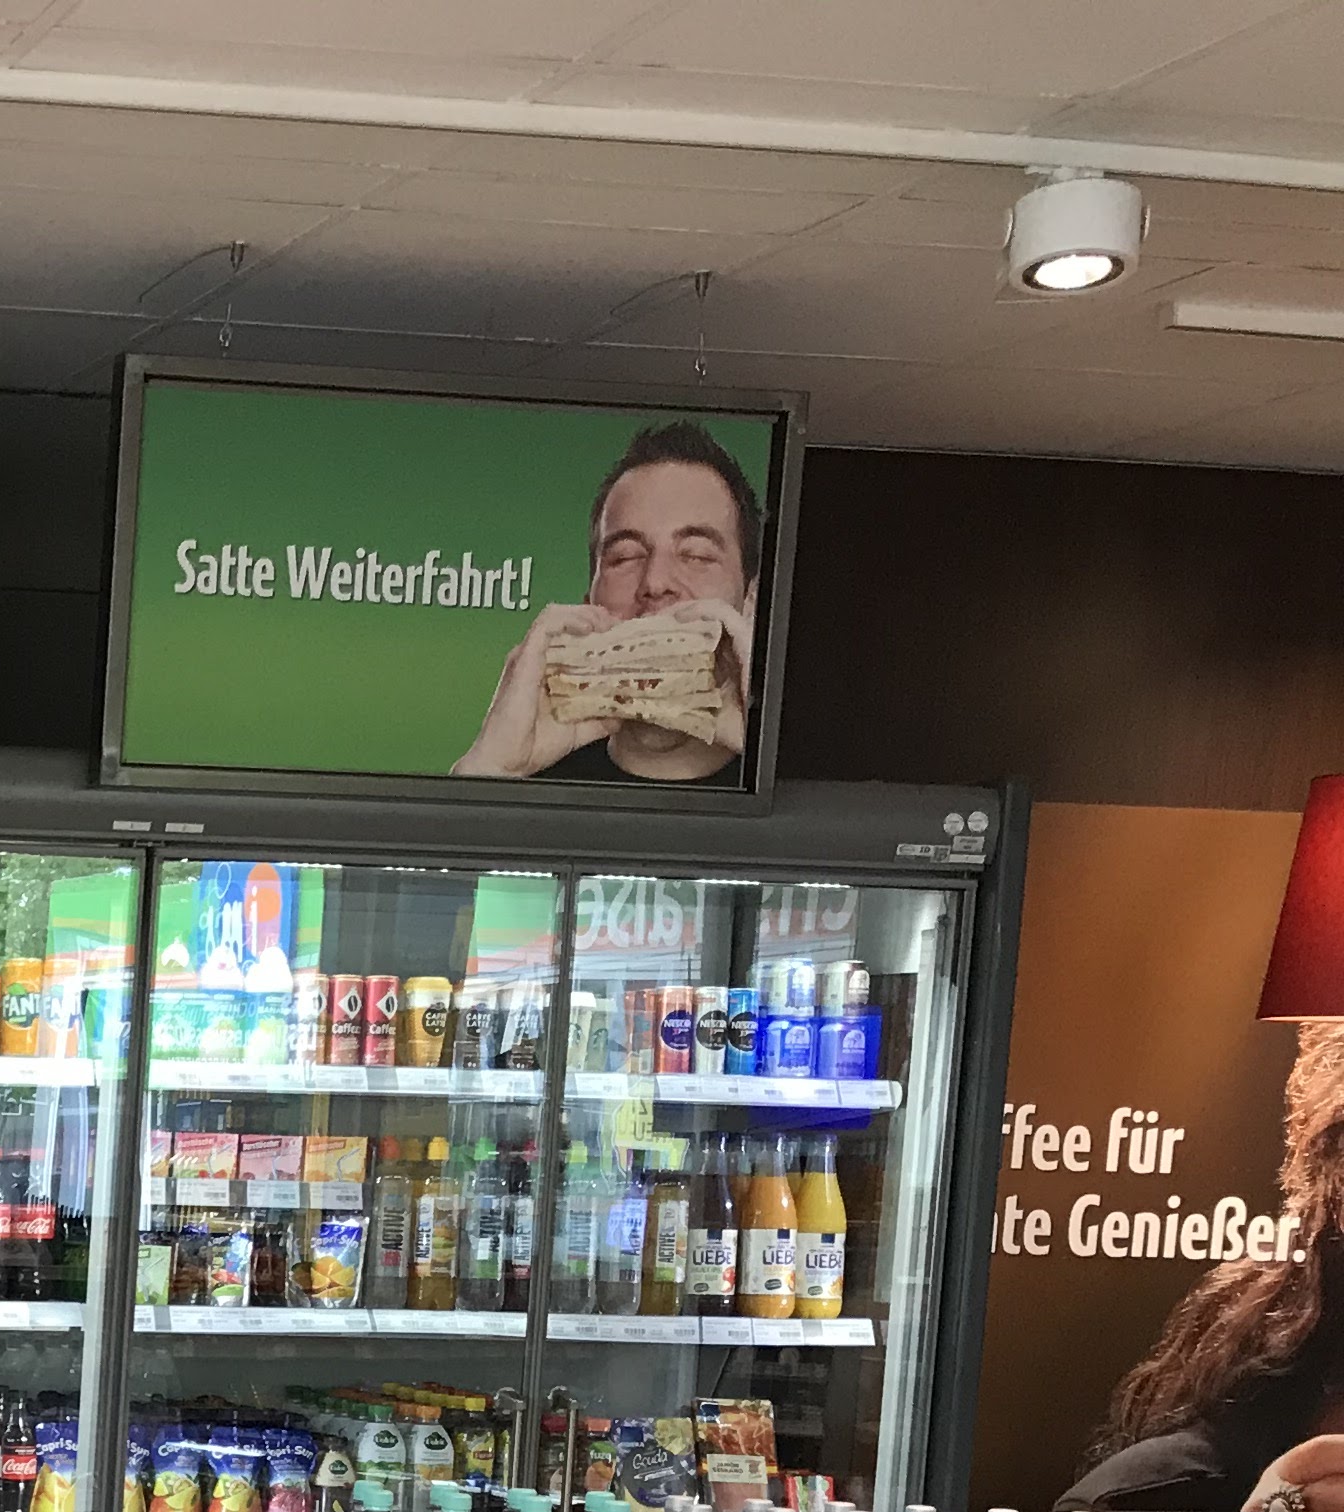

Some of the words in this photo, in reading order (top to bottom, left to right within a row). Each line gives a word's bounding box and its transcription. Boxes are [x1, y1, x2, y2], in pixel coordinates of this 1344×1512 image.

[174, 539, 276, 599] Satte
[286, 545, 534, 611] Weiterfahrt!
[3, 993, 41, 1018] FANT
[663, 1018, 690, 1029] NESCA
[999, 1103, 1092, 1172] ffee
[1107, 1106, 1185, 1174] für
[1068, 1196, 1306, 1264] Genießer.
[692, 1249, 733, 1266] LIEBE
[36, 1438, 78, 1456] Capri-Su
[632, 1449, 669, 1469] Gouda
